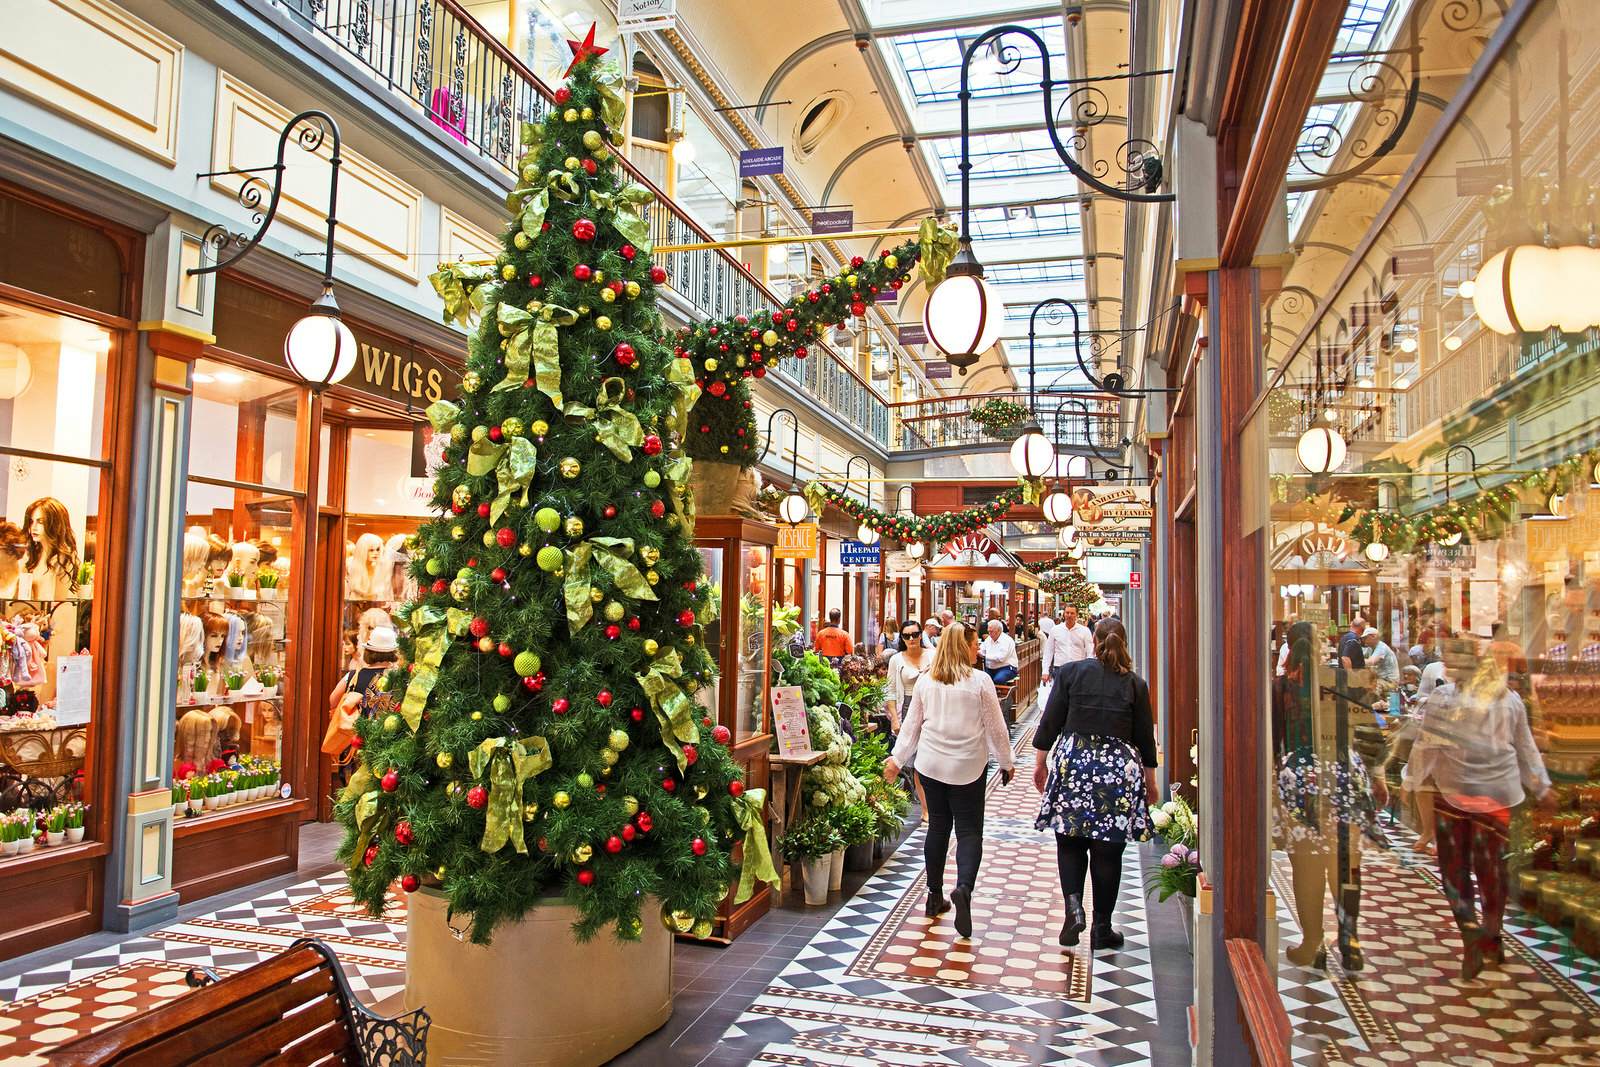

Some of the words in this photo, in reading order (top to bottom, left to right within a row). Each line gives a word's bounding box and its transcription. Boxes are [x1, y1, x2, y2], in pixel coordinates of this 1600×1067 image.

[361, 343, 442, 403] WIGS
[1110, 379, 1117, 388] 7
[952, 536, 990, 553] CIAO
